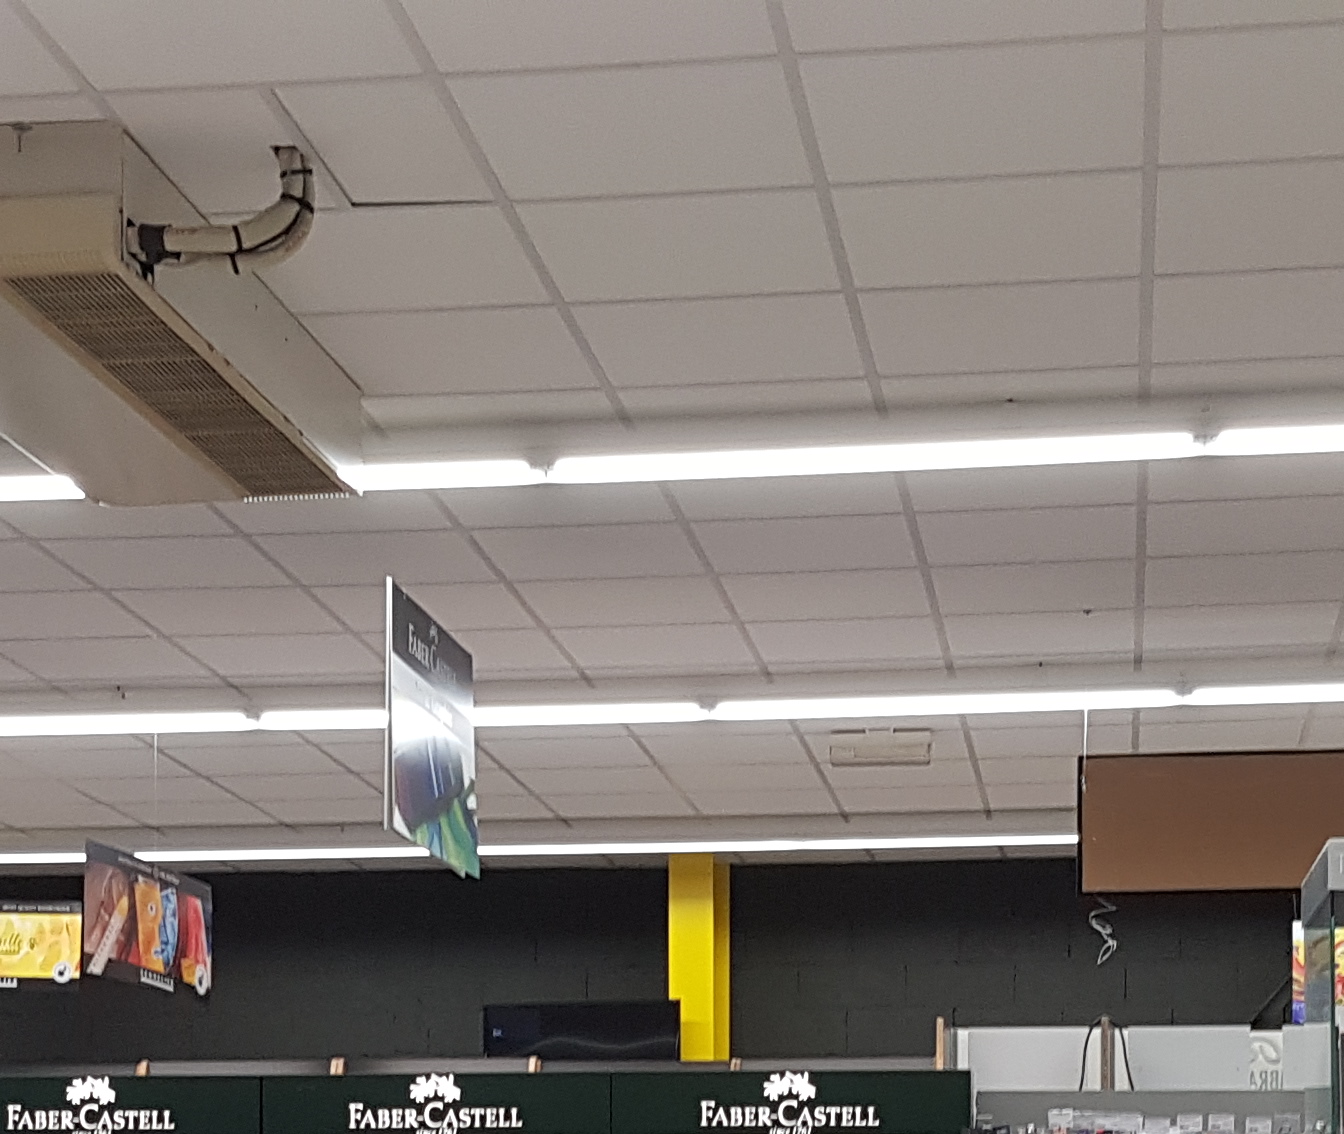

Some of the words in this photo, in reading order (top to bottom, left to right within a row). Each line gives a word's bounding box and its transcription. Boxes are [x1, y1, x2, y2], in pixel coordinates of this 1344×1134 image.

[7, 1103, 175, 1130] FABER-CASTELL
[348, 1101, 523, 1130] FABER-CASTELL
[700, 1100, 880, 1127] FABER-CASTELL
